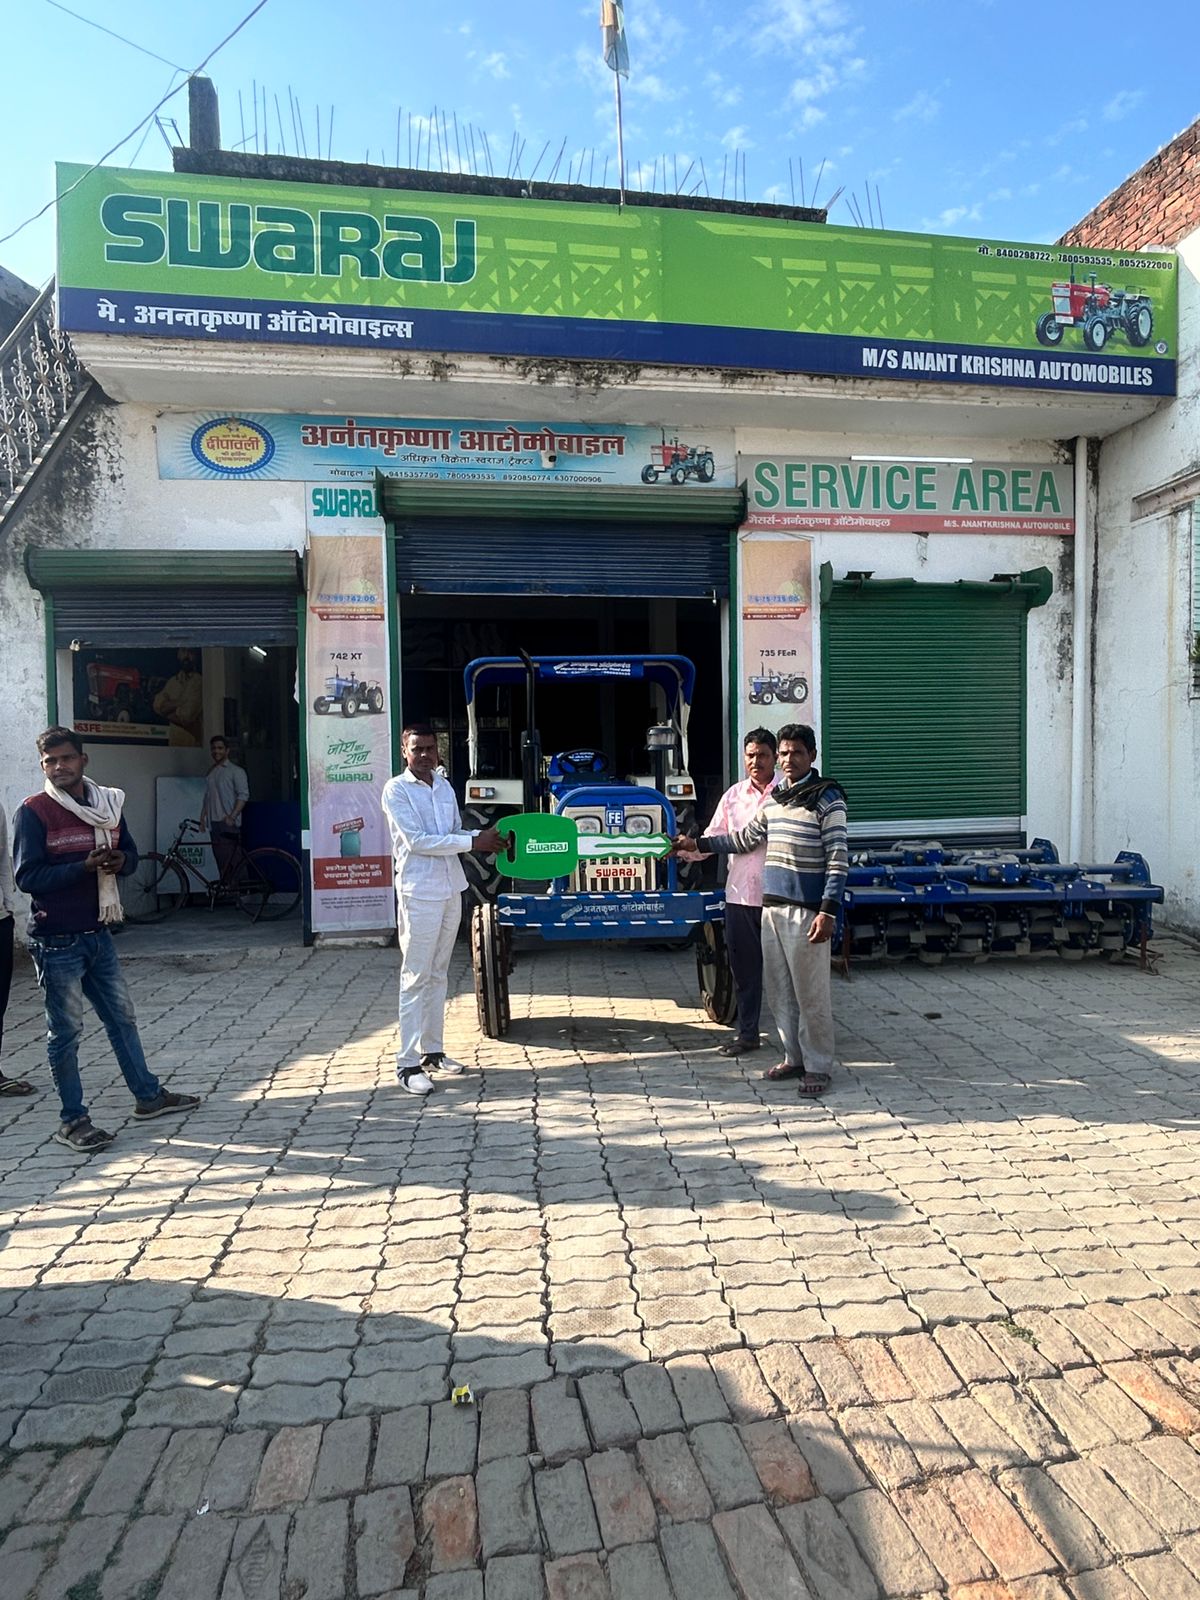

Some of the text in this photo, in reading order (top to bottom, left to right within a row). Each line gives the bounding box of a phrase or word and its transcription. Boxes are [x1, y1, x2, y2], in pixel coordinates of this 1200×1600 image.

[978, 244, 1173, 270] मो. 8400298722, 7800593535, 8052522000
[97, 298, 414, 339] मे. अनन्तकृष्णा ऑटोमोबाइल्स
[862, 347, 1153, 386] M/S ANANT KRISHNA AUTOMOBILES
[206, 435, 260, 451] दीपावली
[301, 418, 625, 457] अनंतकृष्णा आटोमोबाइल
[400, 453, 437, 465] अधिकृत
[446, 472, 496, 480] 7800593535
[754, 461, 1062, 514] SERVICE AREA
[961, 520, 1021, 530] ANANTKRISHNA
[1023, 522, 1071, 531] AUTOMOBILE
[608, 812, 621, 824] FE
